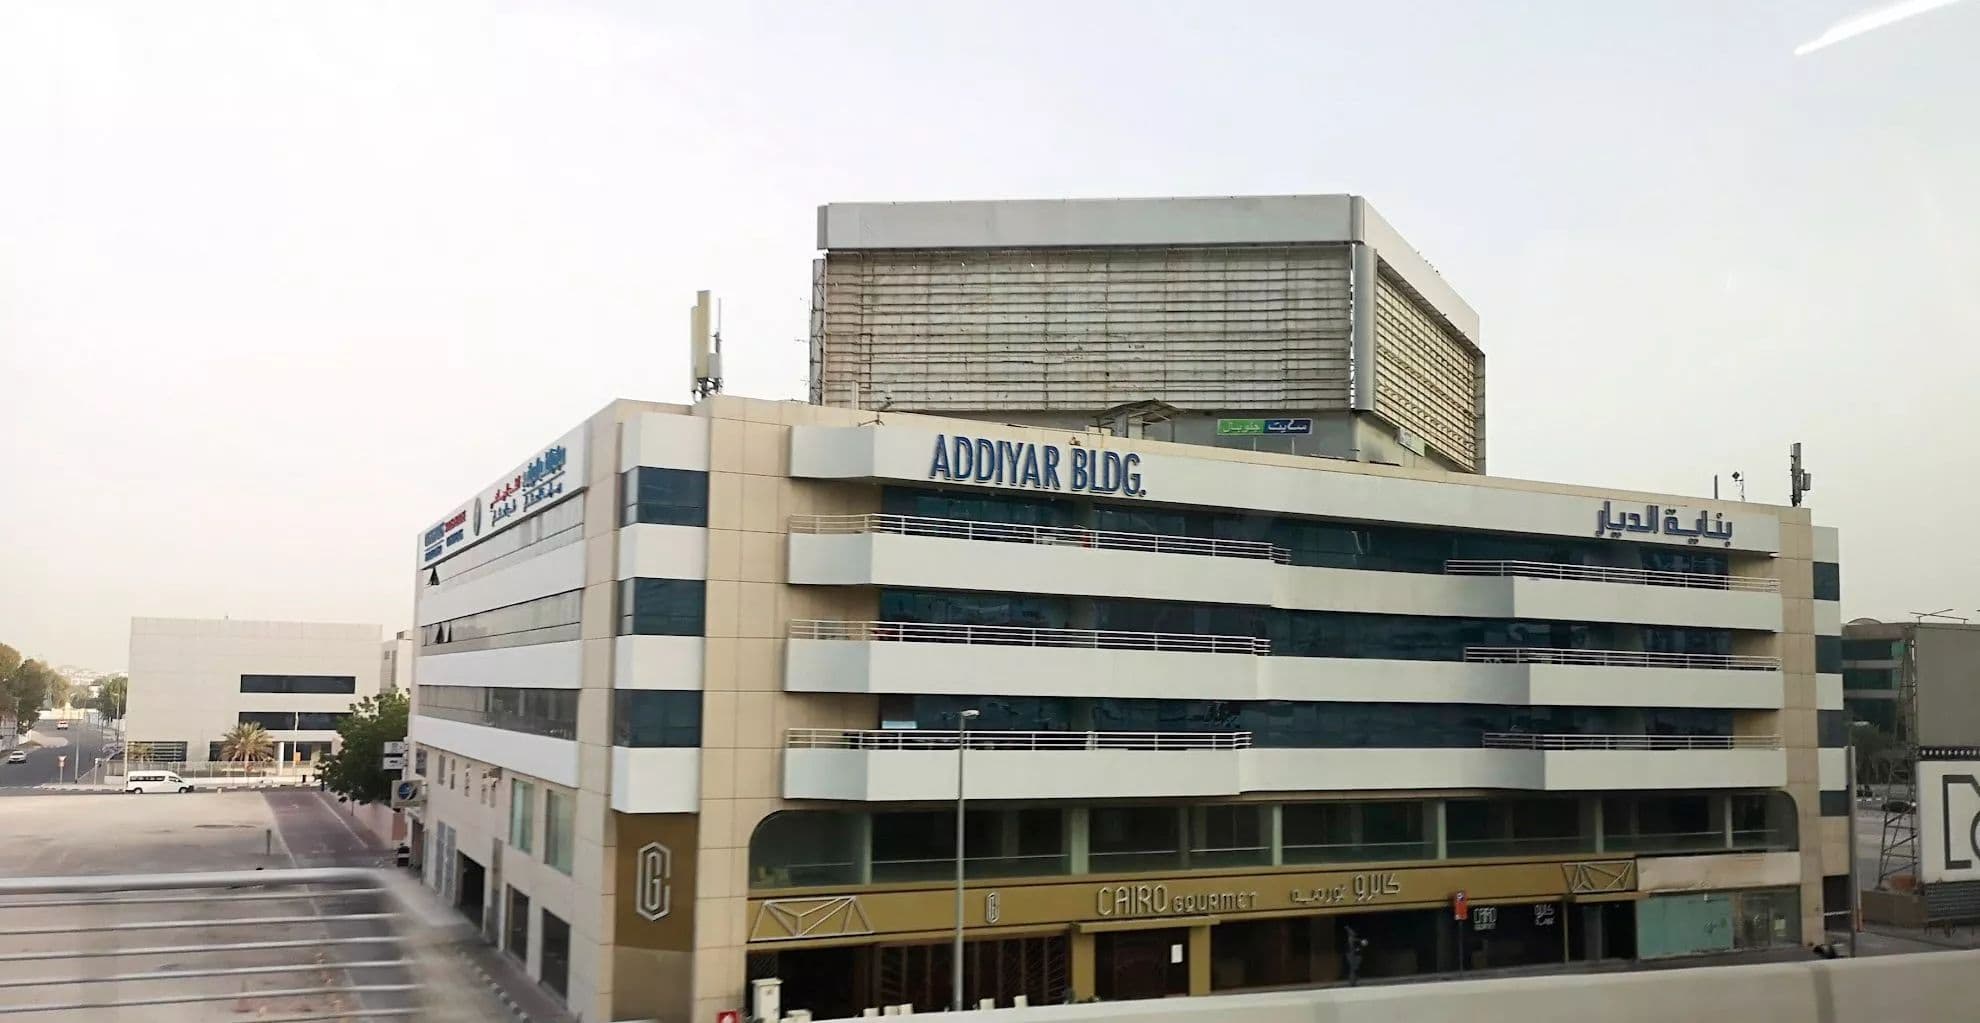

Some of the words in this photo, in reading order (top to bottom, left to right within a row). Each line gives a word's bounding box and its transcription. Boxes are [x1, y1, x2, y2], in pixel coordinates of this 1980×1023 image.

[928, 433, 1061, 491] ADDIYAR
[1071, 447, 1147, 498] BLDG.
[1595, 500, 1660, 538] الديار
[1664, 508, 1733, 548] بناية
[1097, 884, 1169, 916] CAIRO
[1172, 890, 1258, 913] GOURMET
